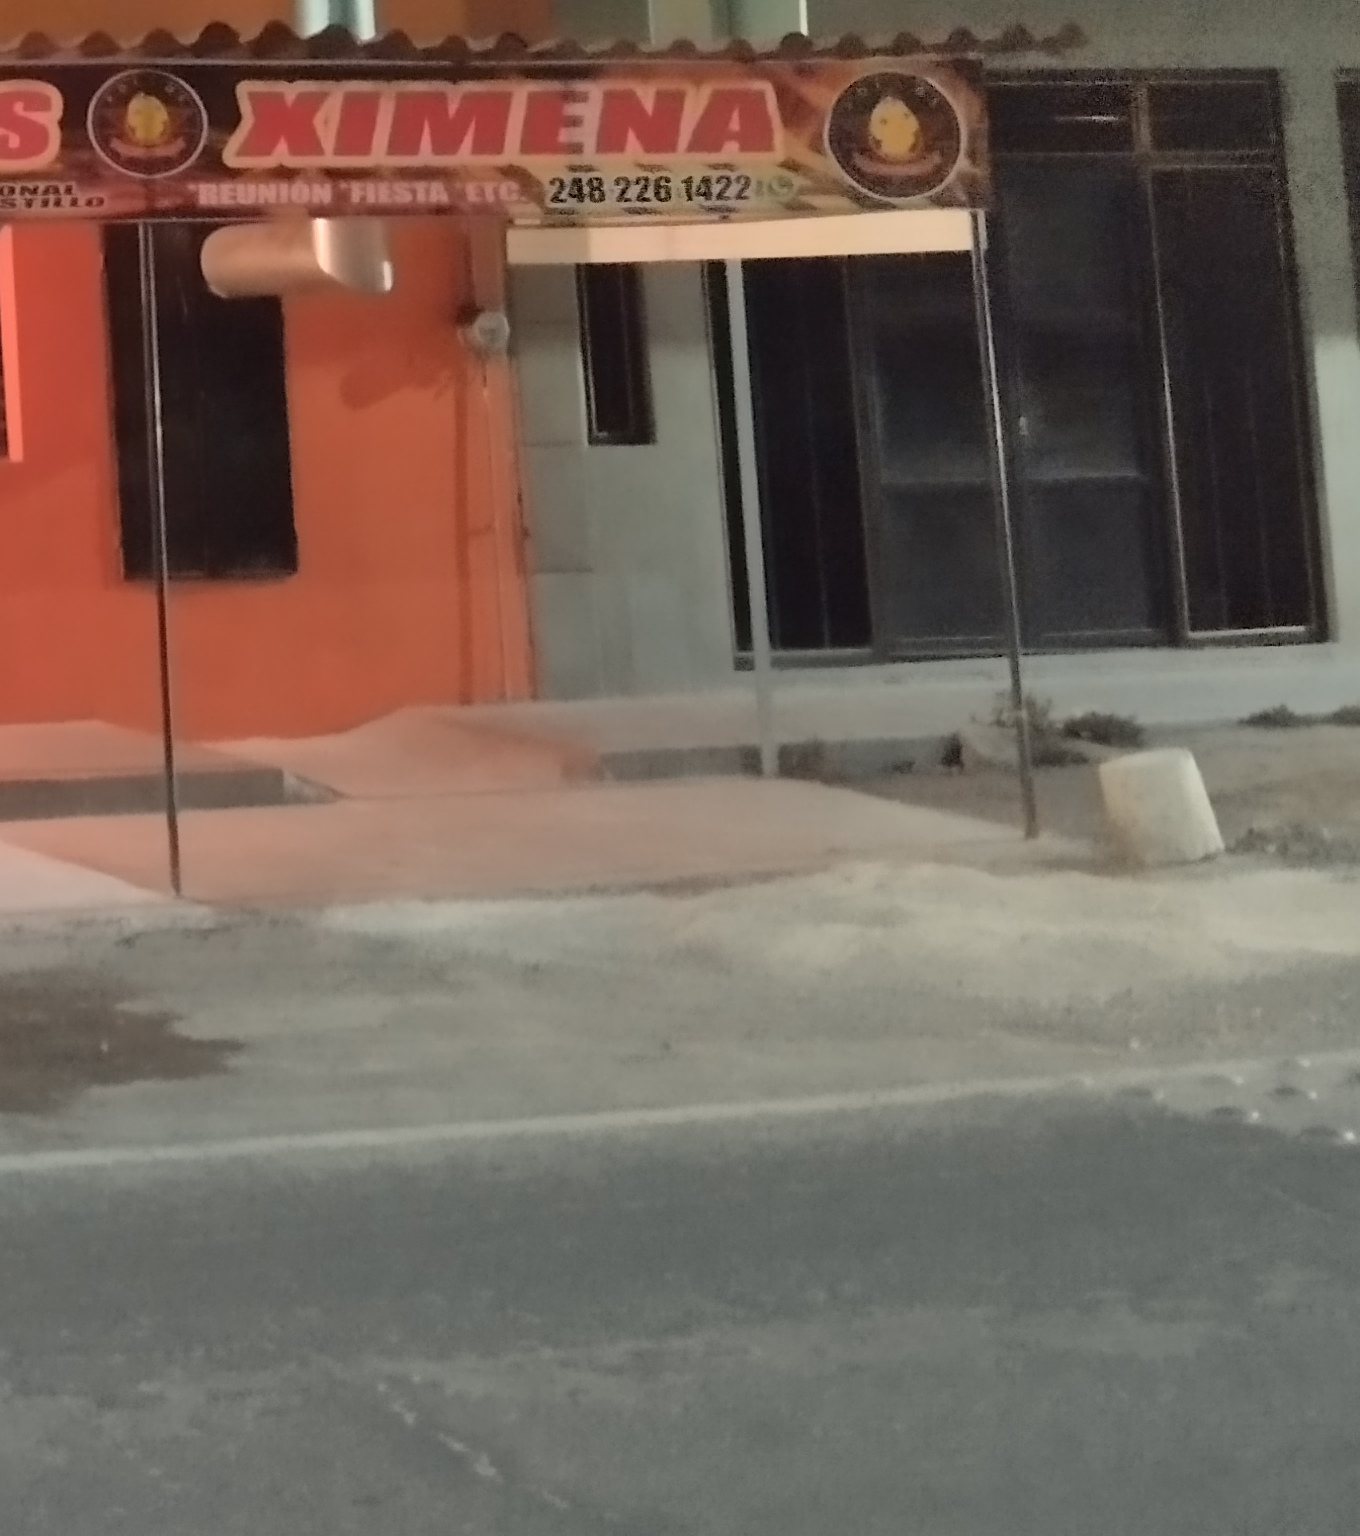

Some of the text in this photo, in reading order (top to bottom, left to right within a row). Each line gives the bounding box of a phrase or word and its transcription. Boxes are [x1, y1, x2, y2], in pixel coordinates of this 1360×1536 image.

[235, 89, 775, 157] XIMENA
[548, 173, 752, 204] 248 226 1422
